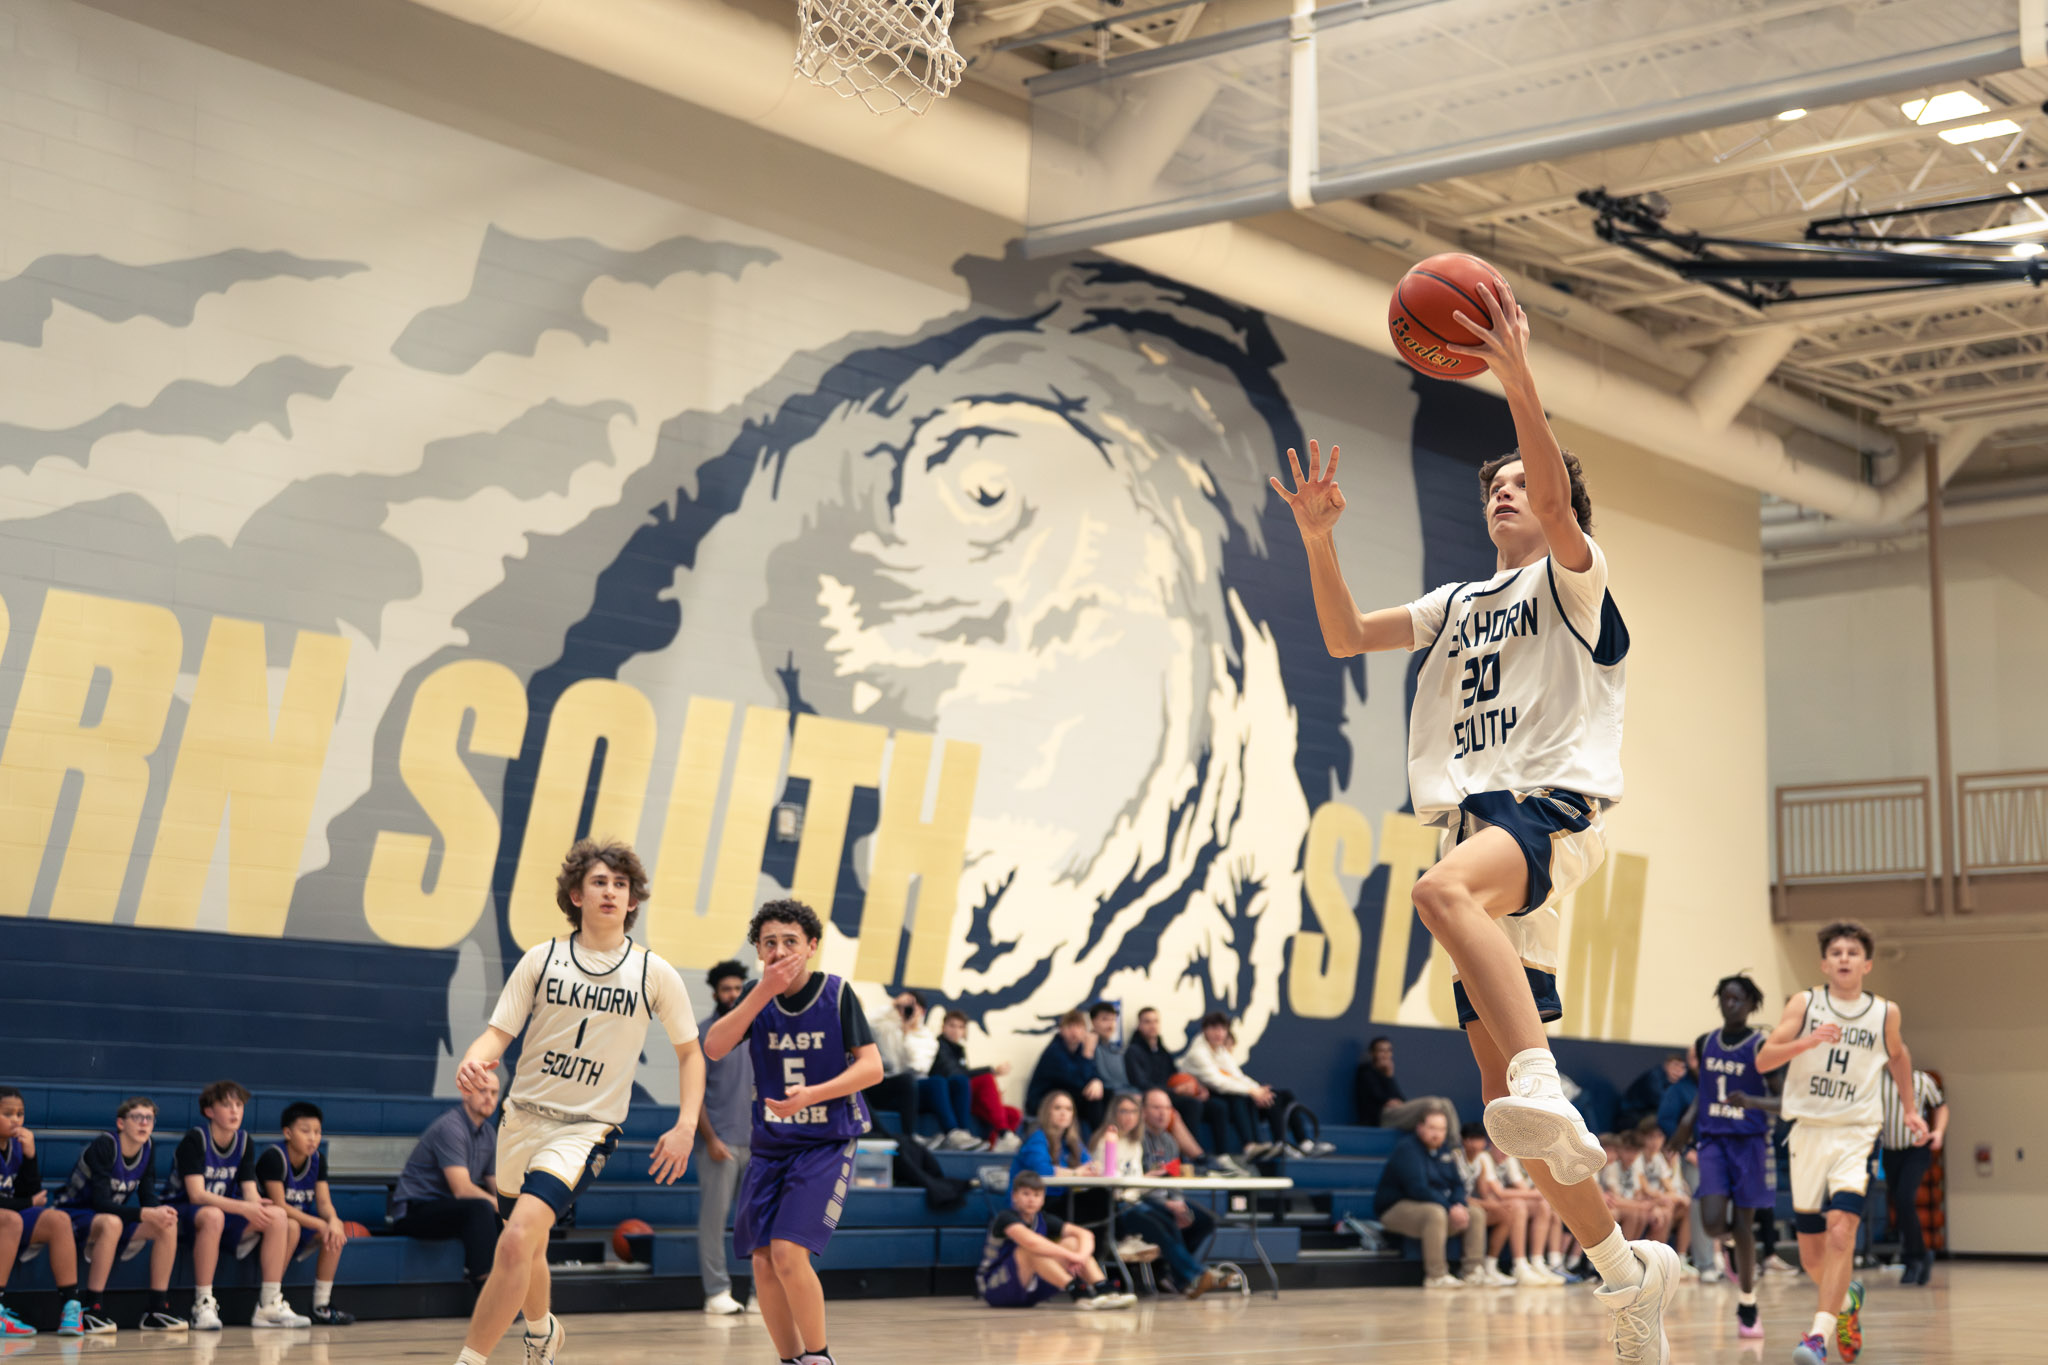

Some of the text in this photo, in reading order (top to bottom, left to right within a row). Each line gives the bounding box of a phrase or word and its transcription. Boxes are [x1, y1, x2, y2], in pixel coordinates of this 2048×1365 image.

[1392, 316, 1461, 368] Baden
[1462, 651, 1500, 709] 30
[1454, 706, 1517, 759] SOUTH
[0, 587, 1649, 1042] RN SOUTH STM
[546, 978, 638, 1017] ELKHORN
[574, 1017, 588, 1049] 1
[768, 1032, 825, 1051] EAST
[541, 1051, 604, 1086] SOUTH
[783, 1057, 806, 1093] 5
[1706, 1057, 1745, 1076] EAST
[1826, 1047, 1850, 1074] 14
[1717, 1075, 1727, 1103] 1
[1810, 1076, 1856, 1102] SOUTH
